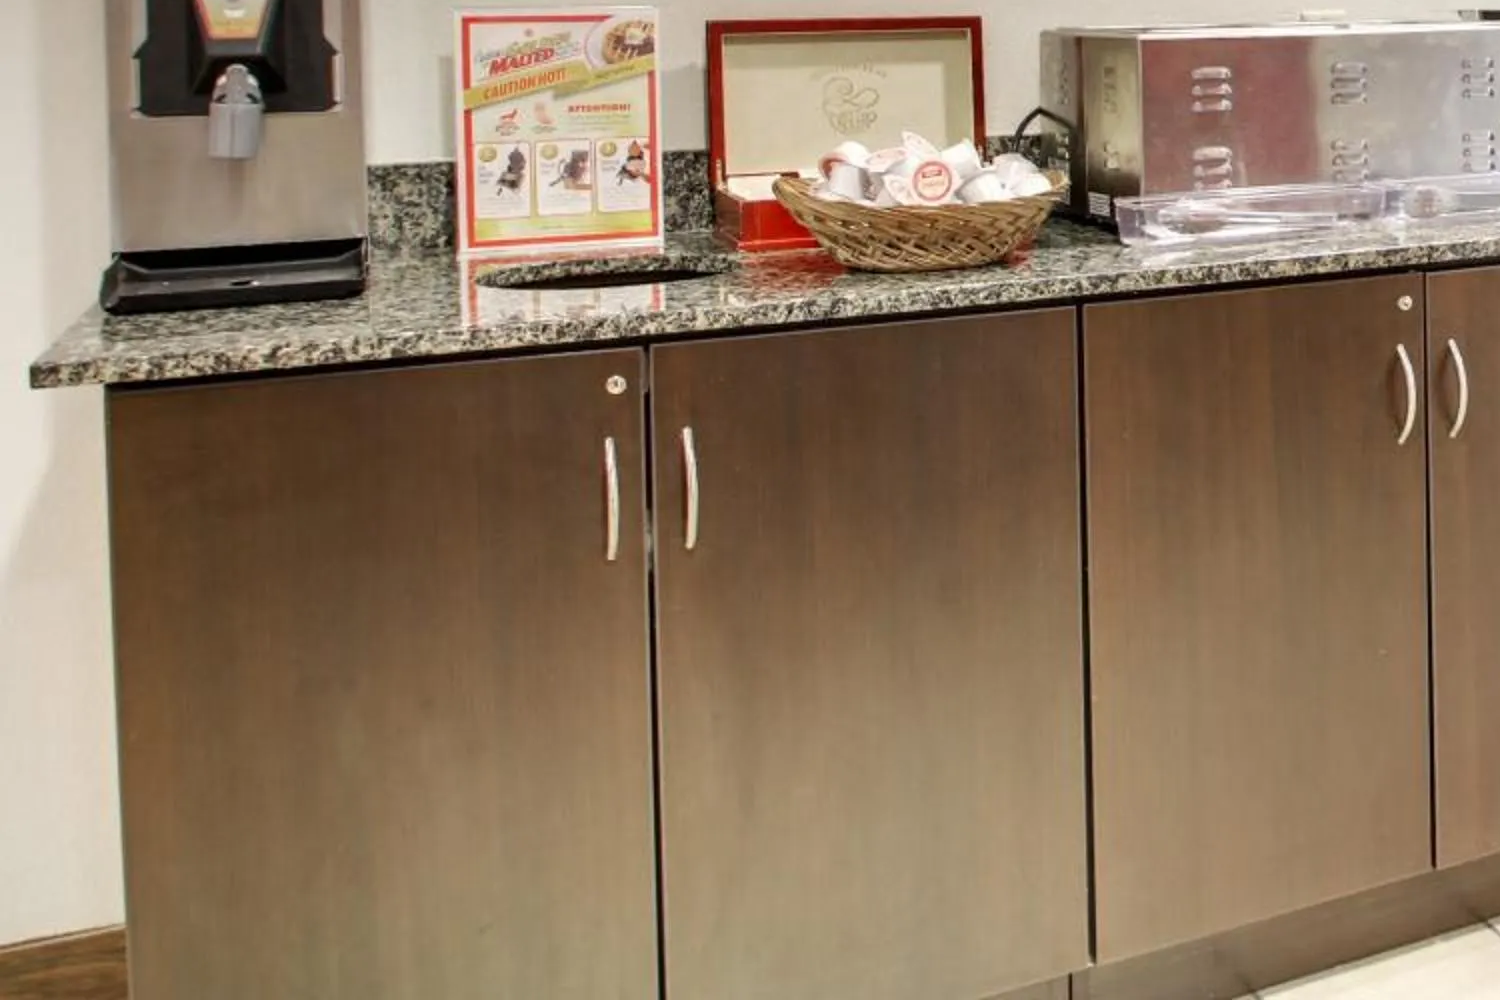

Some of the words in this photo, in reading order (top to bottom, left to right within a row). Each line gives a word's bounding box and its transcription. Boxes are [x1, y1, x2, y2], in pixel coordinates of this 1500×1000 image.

[488, 46, 556, 77] MALTED
[482, 72, 538, 100] CAUTION
[537, 67, 568, 87] HOT!
[567, 102, 631, 114] ATTENTION!
